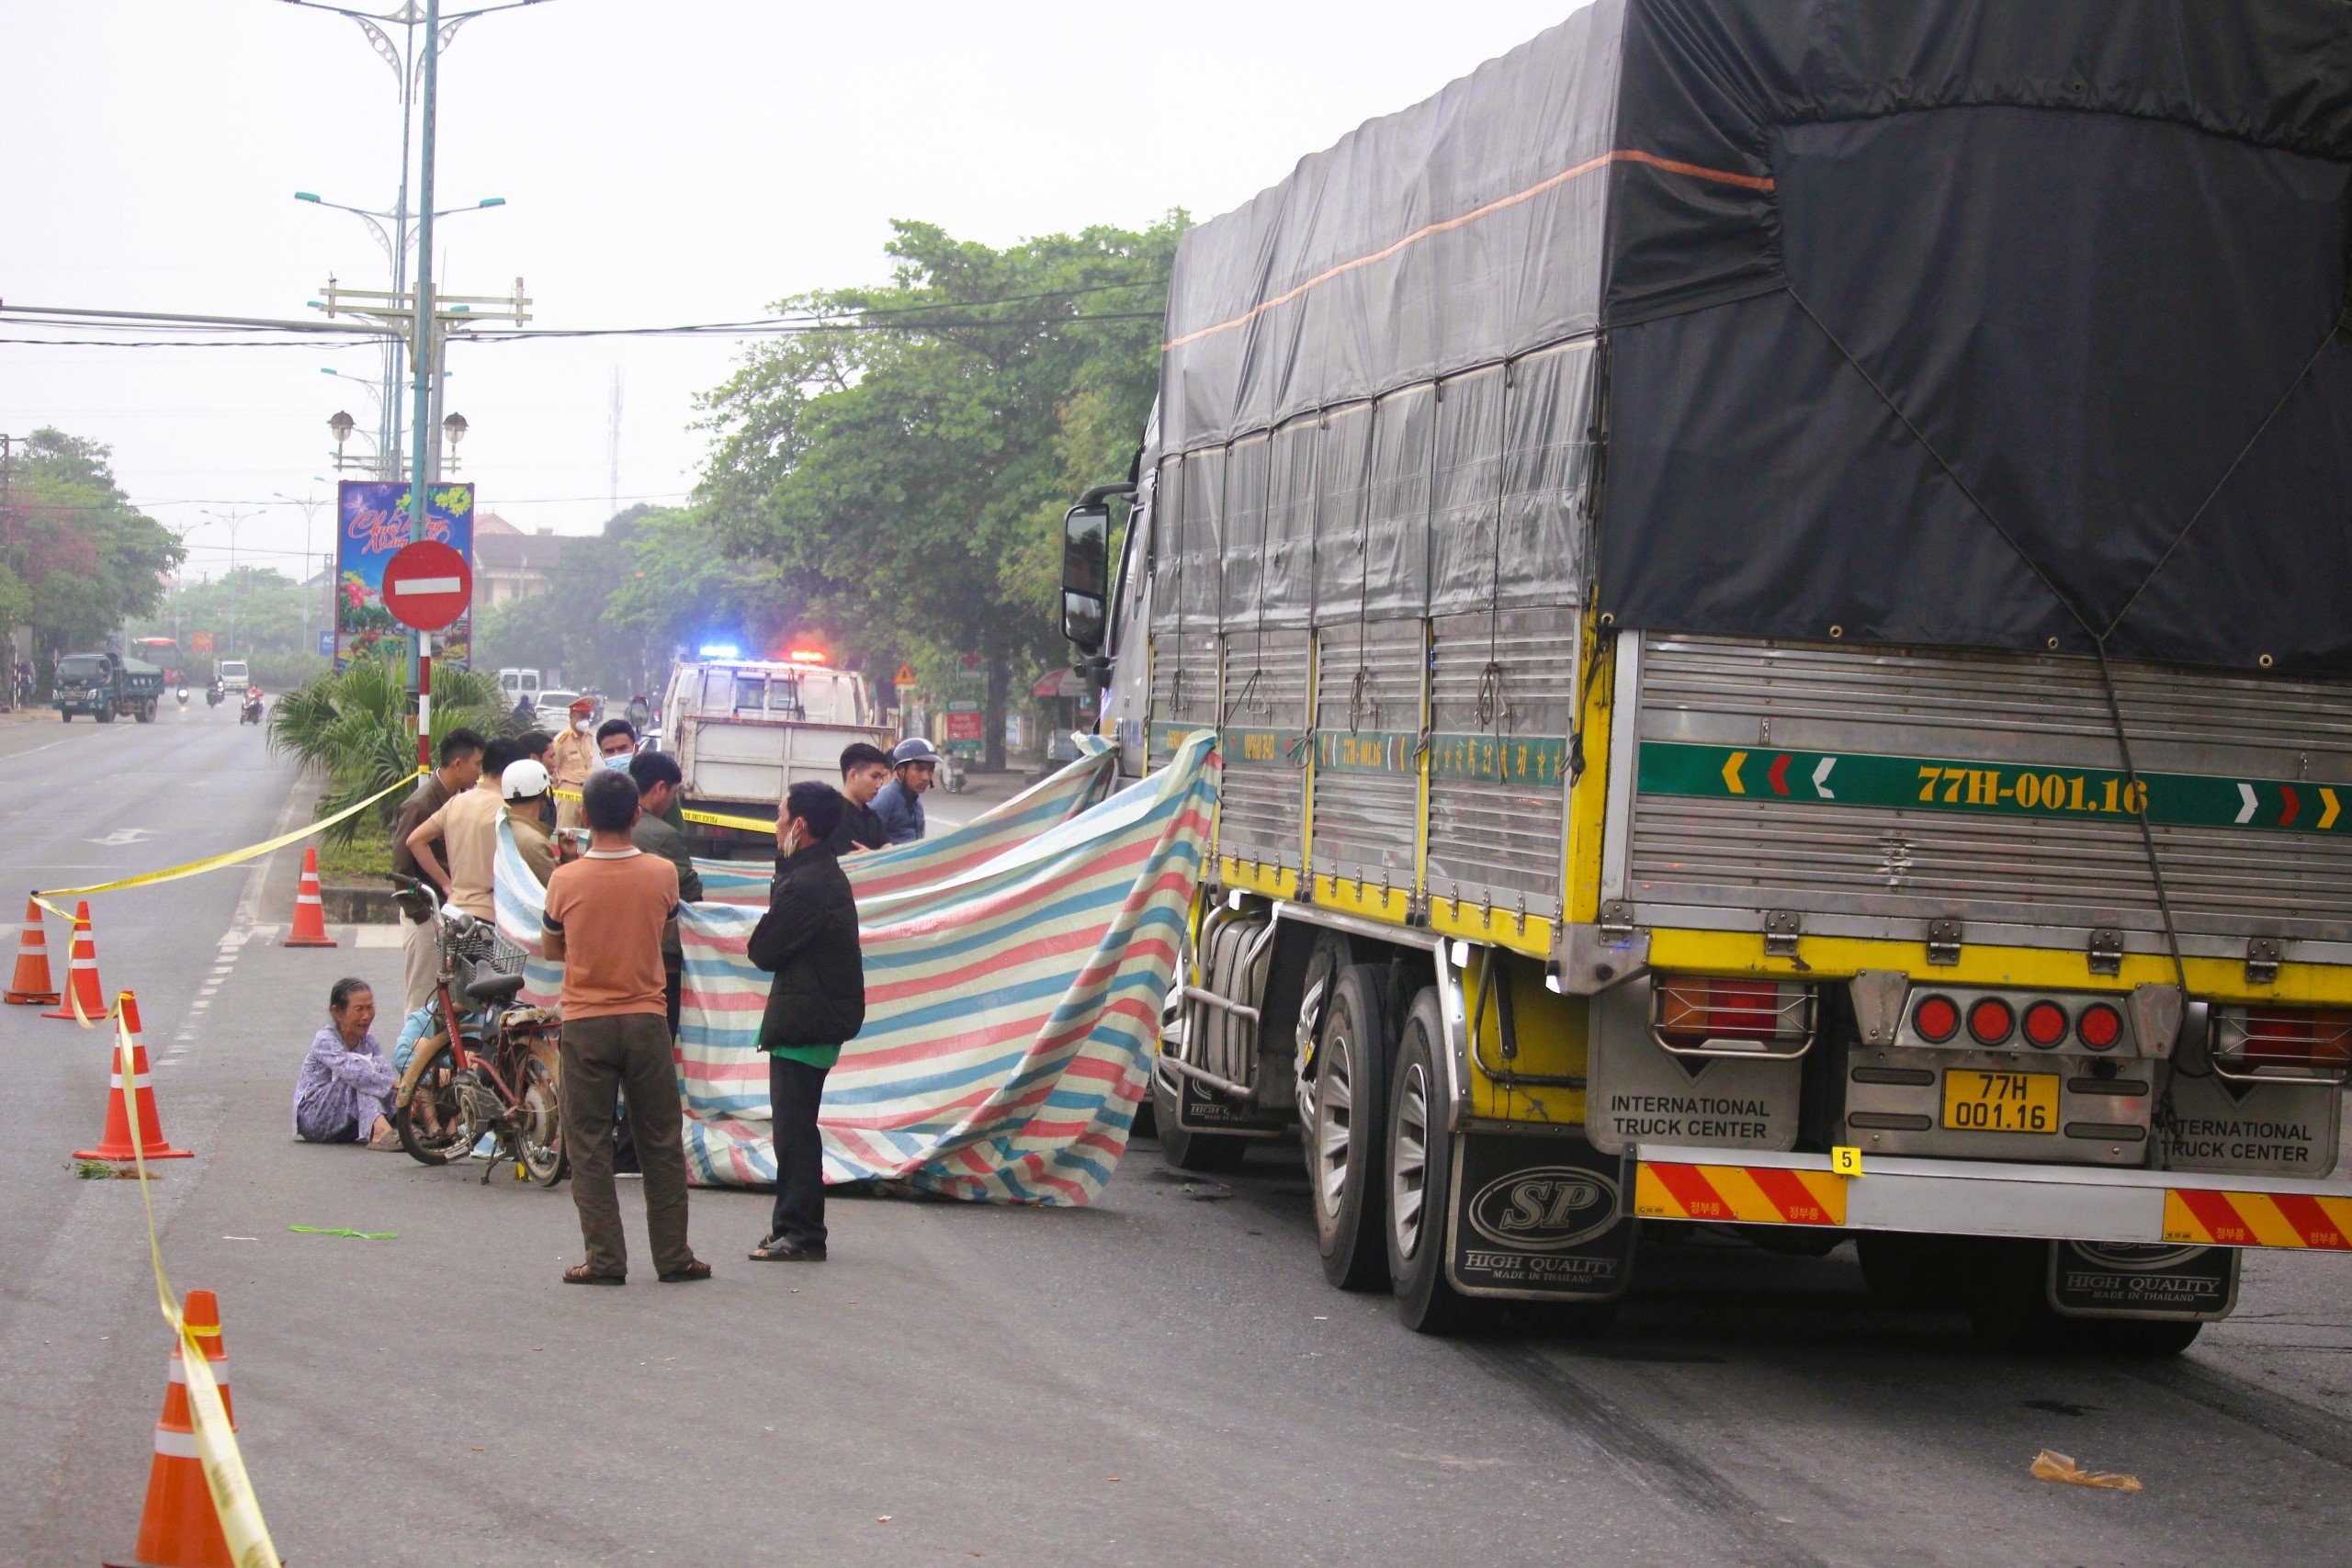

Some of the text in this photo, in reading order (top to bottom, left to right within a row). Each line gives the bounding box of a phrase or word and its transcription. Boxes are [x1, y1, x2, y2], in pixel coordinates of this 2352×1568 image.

[1917, 765, 2149, 815] 77H-001.16
[1979, 1074, 2028, 1100] 77H
[1611, 1095, 1770, 1117] INTERNATIONAL
[1956, 1102, 2046, 1130] 001.16
[1613, 1118, 1767, 1139] TRUCK CENTER
[1842, 1151, 1853, 1168] 5
[2161, 1140, 2309, 1162] TRUCK CENTER
[1499, 1180, 1600, 1230] SP
[1465, 1253, 1619, 1273] HIGH QUALITY
[1492, 1270, 1593, 1283] MADE IN THAILAND
[2067, 1275, 2220, 1293] HIGH QUALITY
[2092, 1291, 2195, 1302] MADE IN THAILAND
